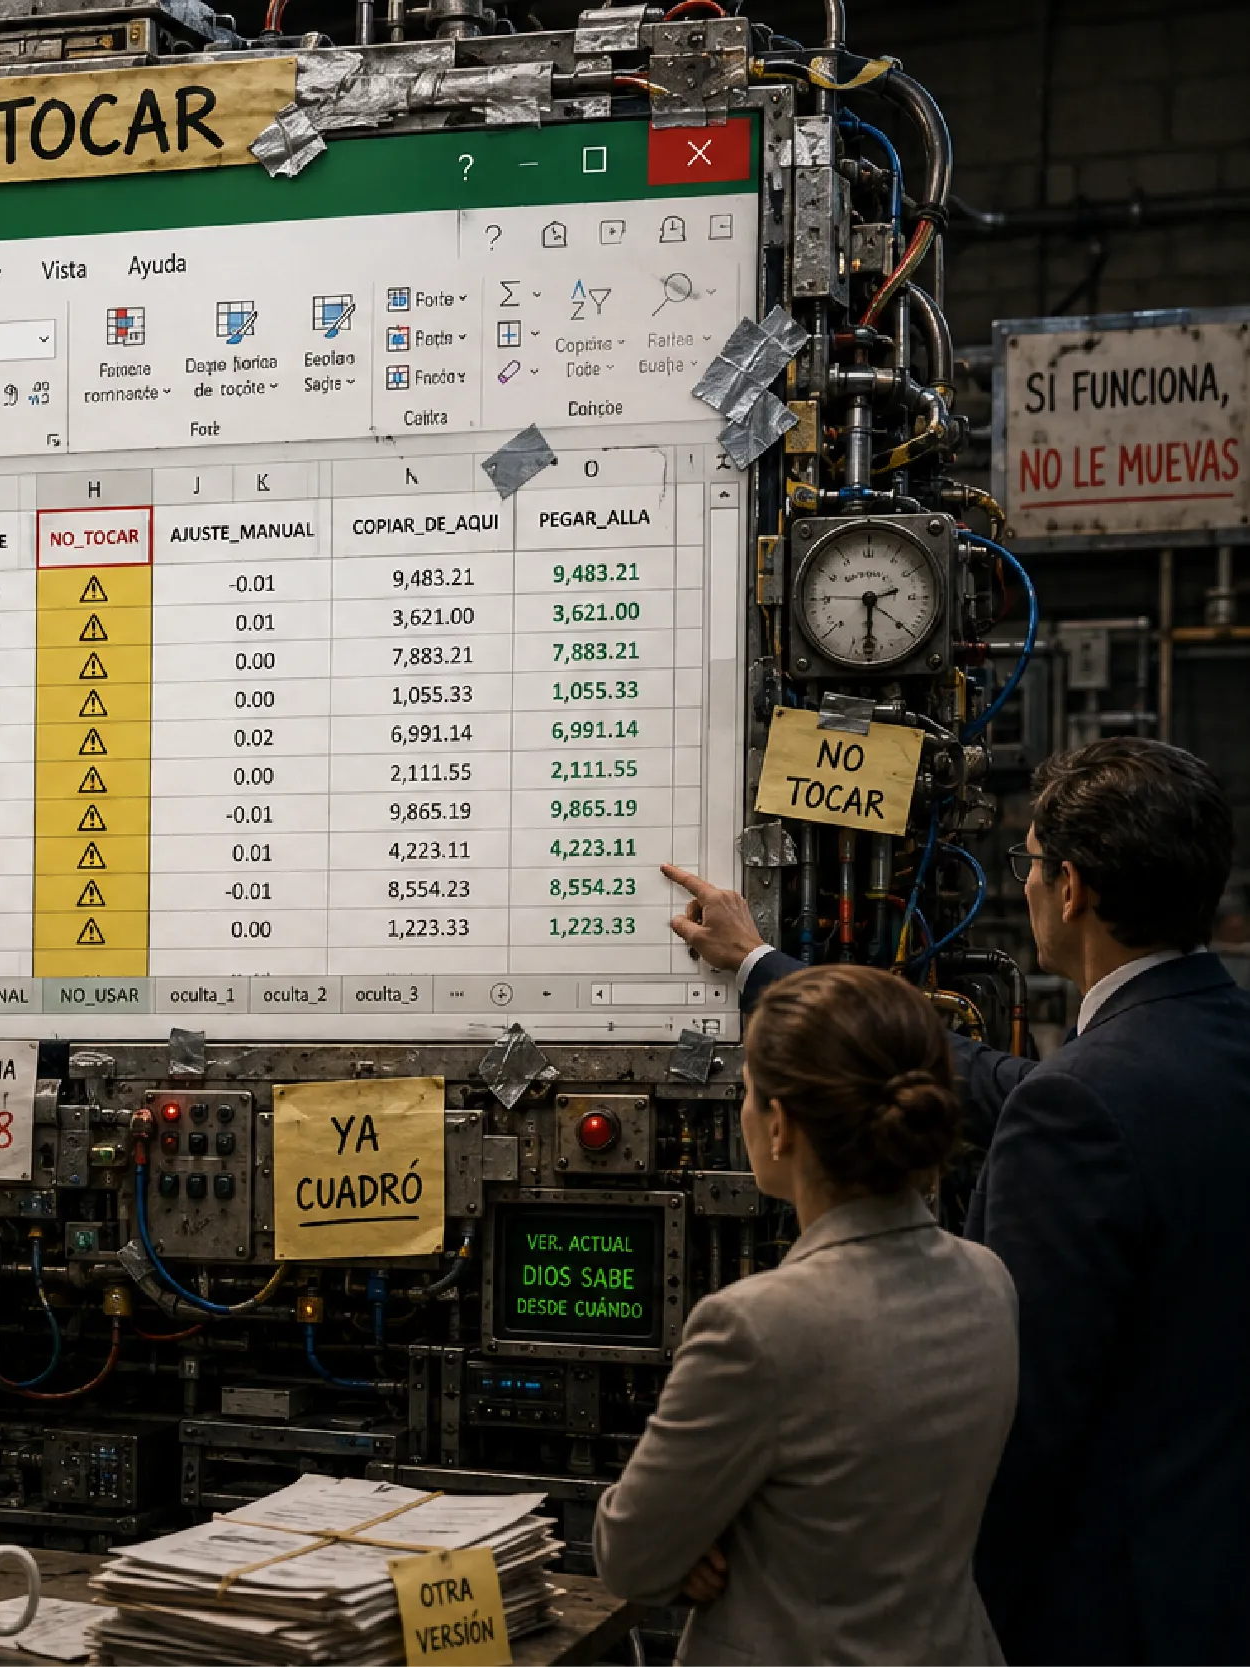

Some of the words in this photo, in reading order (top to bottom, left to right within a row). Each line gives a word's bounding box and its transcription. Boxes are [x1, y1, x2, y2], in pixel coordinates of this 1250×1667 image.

[42, 261, 87, 279] Vista
[128, 253, 186, 279] Ayuda
[1073, 362, 1229, 411] FUNCIONA,
[1018, 446, 1064, 492] NO
[1075, 446, 1105, 489] LE
[1117, 436, 1238, 487] MUEVAS
[89, 481, 100, 497] H
[51, 529, 138, 548] NO_TOCAR
[171, 522, 315, 544] AJUSTE_MANUAL
[353, 515, 498, 535] COPIAR_DE_AQUI
[540, 509, 650, 529] PEGAR_ALLA
[229, 575, 275, 593] -0.01
[393, 568, 474, 590] 9,483.21
[554, 563, 639, 585] 9,483.21
[236, 615, 274, 631] 0.01
[393, 608, 474, 629] 3,621.00
[553, 603, 639, 624] 3,621.00
[236, 653, 275, 669] 0.00
[393, 646, 472, 667] 7,883.21
[553, 641, 639, 664] 7,883.21
[236, 691, 274, 709] 0.00
[393, 686, 472, 707] 1,055.33
[553, 681, 639, 704] 1,055.33
[234, 729, 274, 747] 0.02
[391, 725, 472, 745] 6,991.14
[553, 720, 639, 742] 6,991.14
[817, 740, 863, 771] NO
[234, 768, 274, 785] 0.00
[391, 763, 470, 785] 2,111.55
[551, 760, 637, 781] 2,111.55
[226, 806, 272, 823] -0.01
[391, 803, 470, 823] 9,865.19
[551, 800, 637, 821] 9,865.19
[785, 776, 883, 821] TOCAR
[232, 844, 272, 861] 0.01
[389, 841, 470, 862] 4,223.11
[550, 839, 635, 861] 4,223.11
[226, 882, 271, 899] -0.01
[389, 881, 469, 900] 8,554.23
[550, 879, 635, 899] 8,554.23
[232, 922, 270, 938] 0.00
[389, 919, 469, 940] 1,223.33
[550, 917, 635, 938] 1,223.33
[61, 988, 138, 1006] NO_USAR
[171, 988, 234, 1004] oculta_1
[264, 986, 327, 1004] oculta_2
[356, 986, 417, 1004] oculta_3
[331, 1115, 379, 1155] YA
[297, 1158, 422, 1211] CUADRÓ
[528, 1234, 563, 1251] VER.
[569, 1236, 632, 1252] ACTUAL
[525, 1265, 571, 1287] DIOS
[581, 1267, 634, 1289] SABE
[518, 1298, 566, 1315] DESDE
[576, 1297, 642, 1318] CUÁNDO
[418, 1577, 474, 1607] OTRA
[416, 1606, 494, 1654] VERSIÓN
